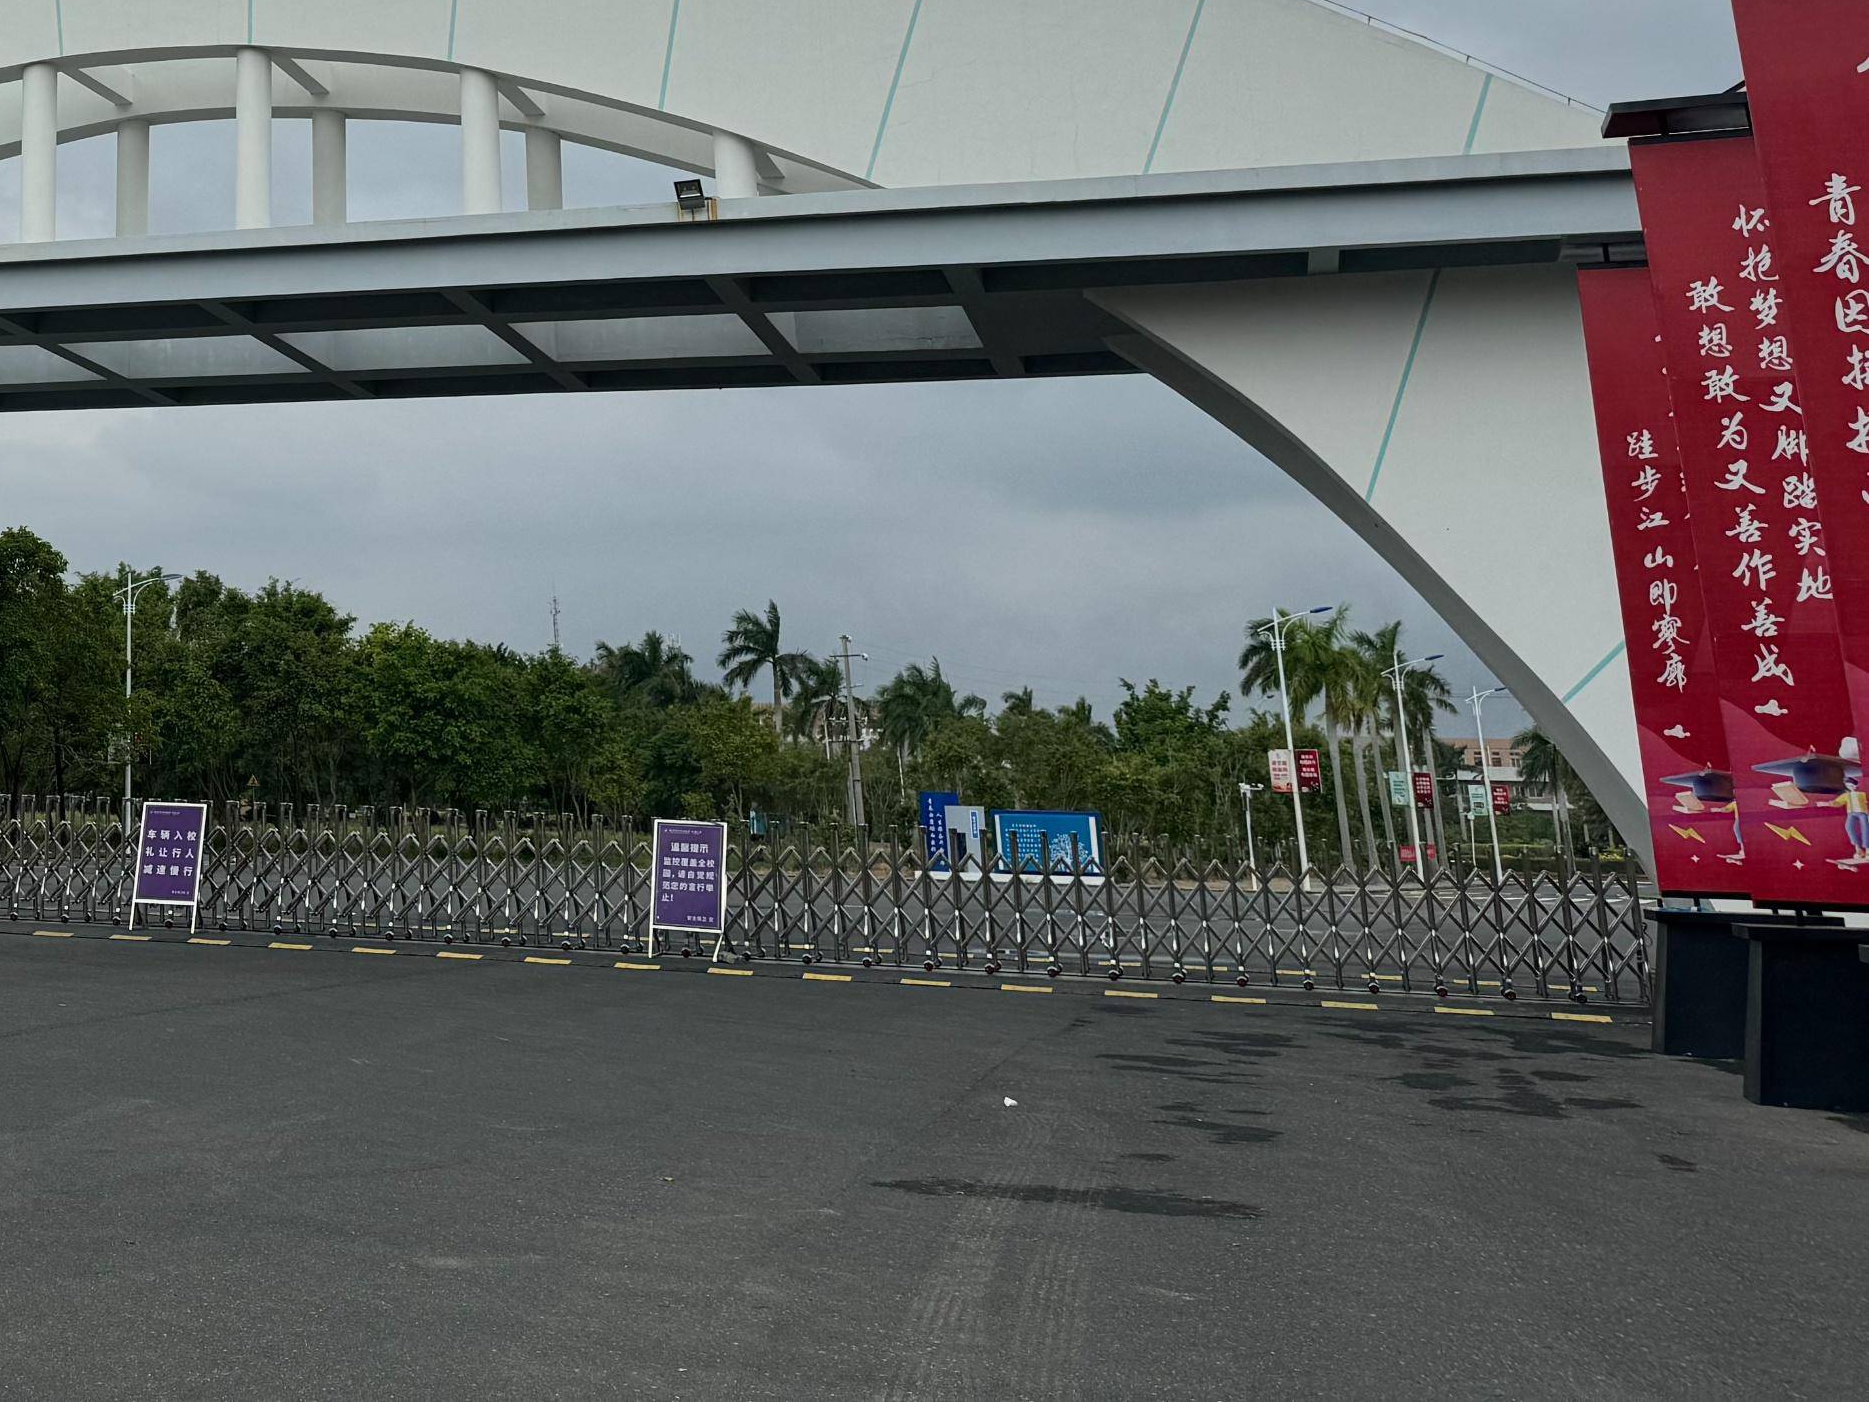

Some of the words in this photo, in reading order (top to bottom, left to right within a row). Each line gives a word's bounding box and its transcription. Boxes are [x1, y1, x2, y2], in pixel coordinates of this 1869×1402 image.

[1731, 203, 1834, 602] 怀抱梦想又脚踏实地
[1685, 275, 1795, 686] 敢想敢为又善作善成
[147, 829, 197, 841] 车辆入校
[145, 846, 194, 859] 礼让行人
[143, 864, 193, 877] 减速慢行
